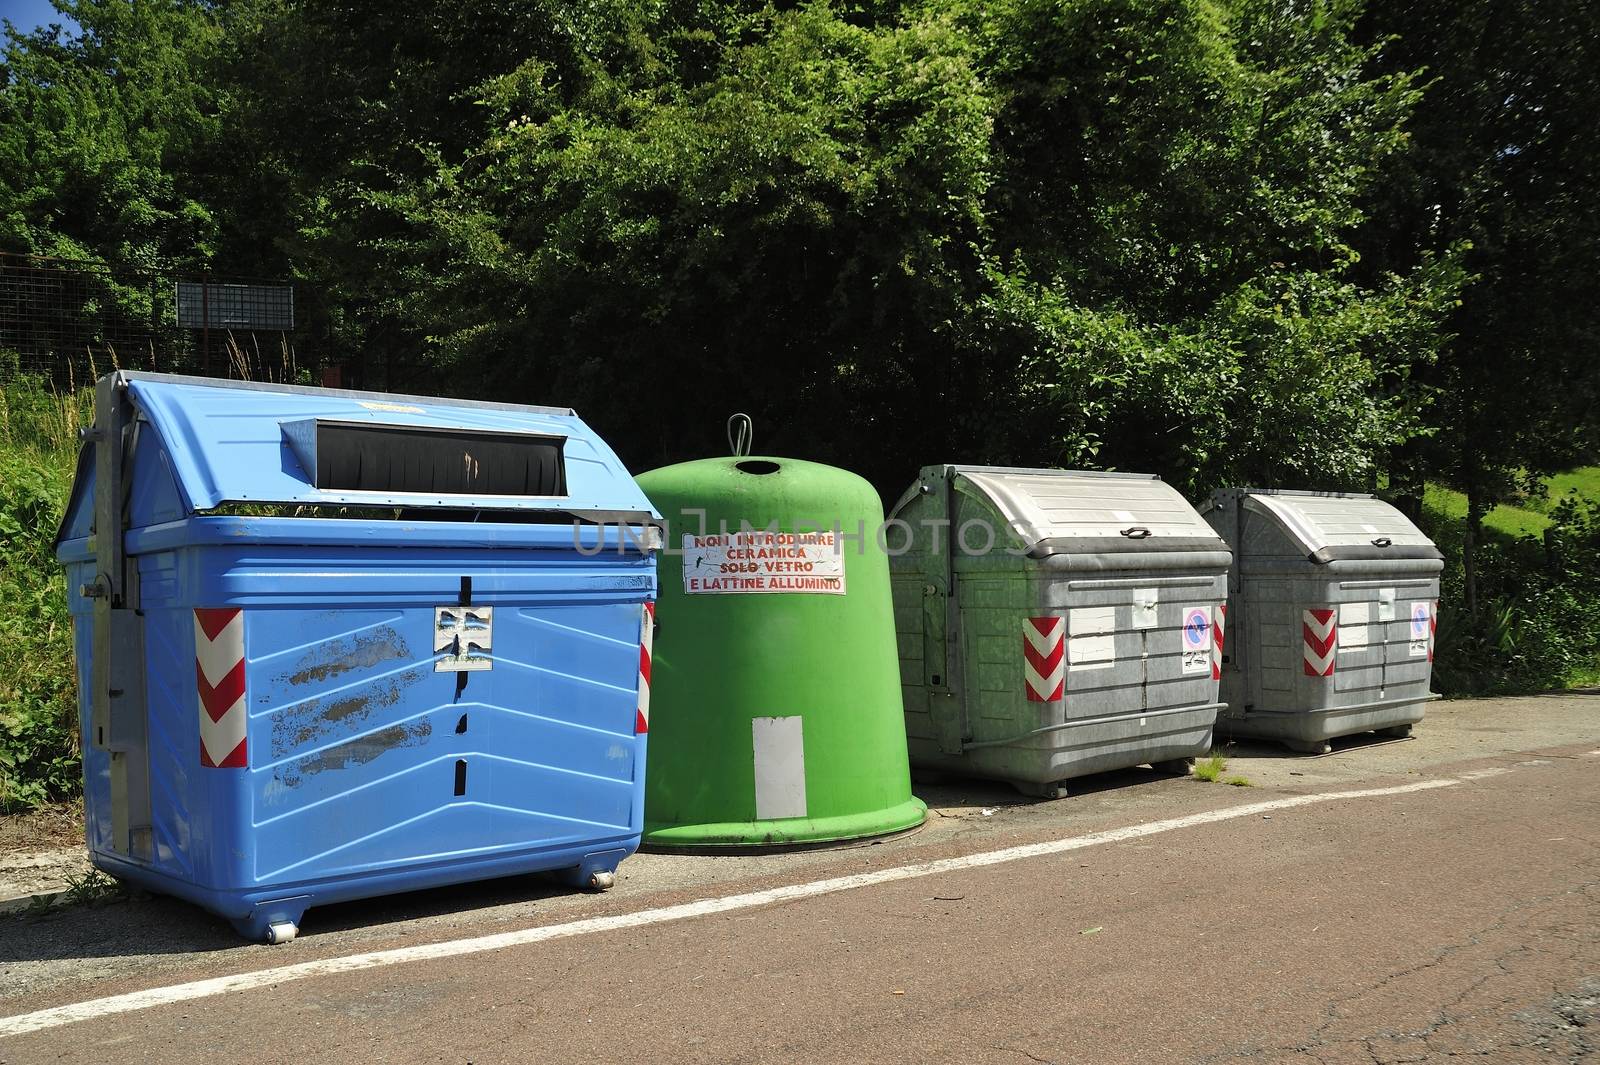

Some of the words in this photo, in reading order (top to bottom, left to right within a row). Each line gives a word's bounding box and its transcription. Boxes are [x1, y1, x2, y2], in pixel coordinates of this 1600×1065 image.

[694, 536, 729, 548] NON
[737, 533, 834, 546] INTRODURRE
[726, 547, 807, 560] CERAMICA
[720, 562, 759, 574] SOLO
[764, 561, 814, 572] VETRO
[690, 578, 699, 590] E
[703, 577, 765, 590] LATTINE
[768, 577, 841, 590] ALLUMINIO
